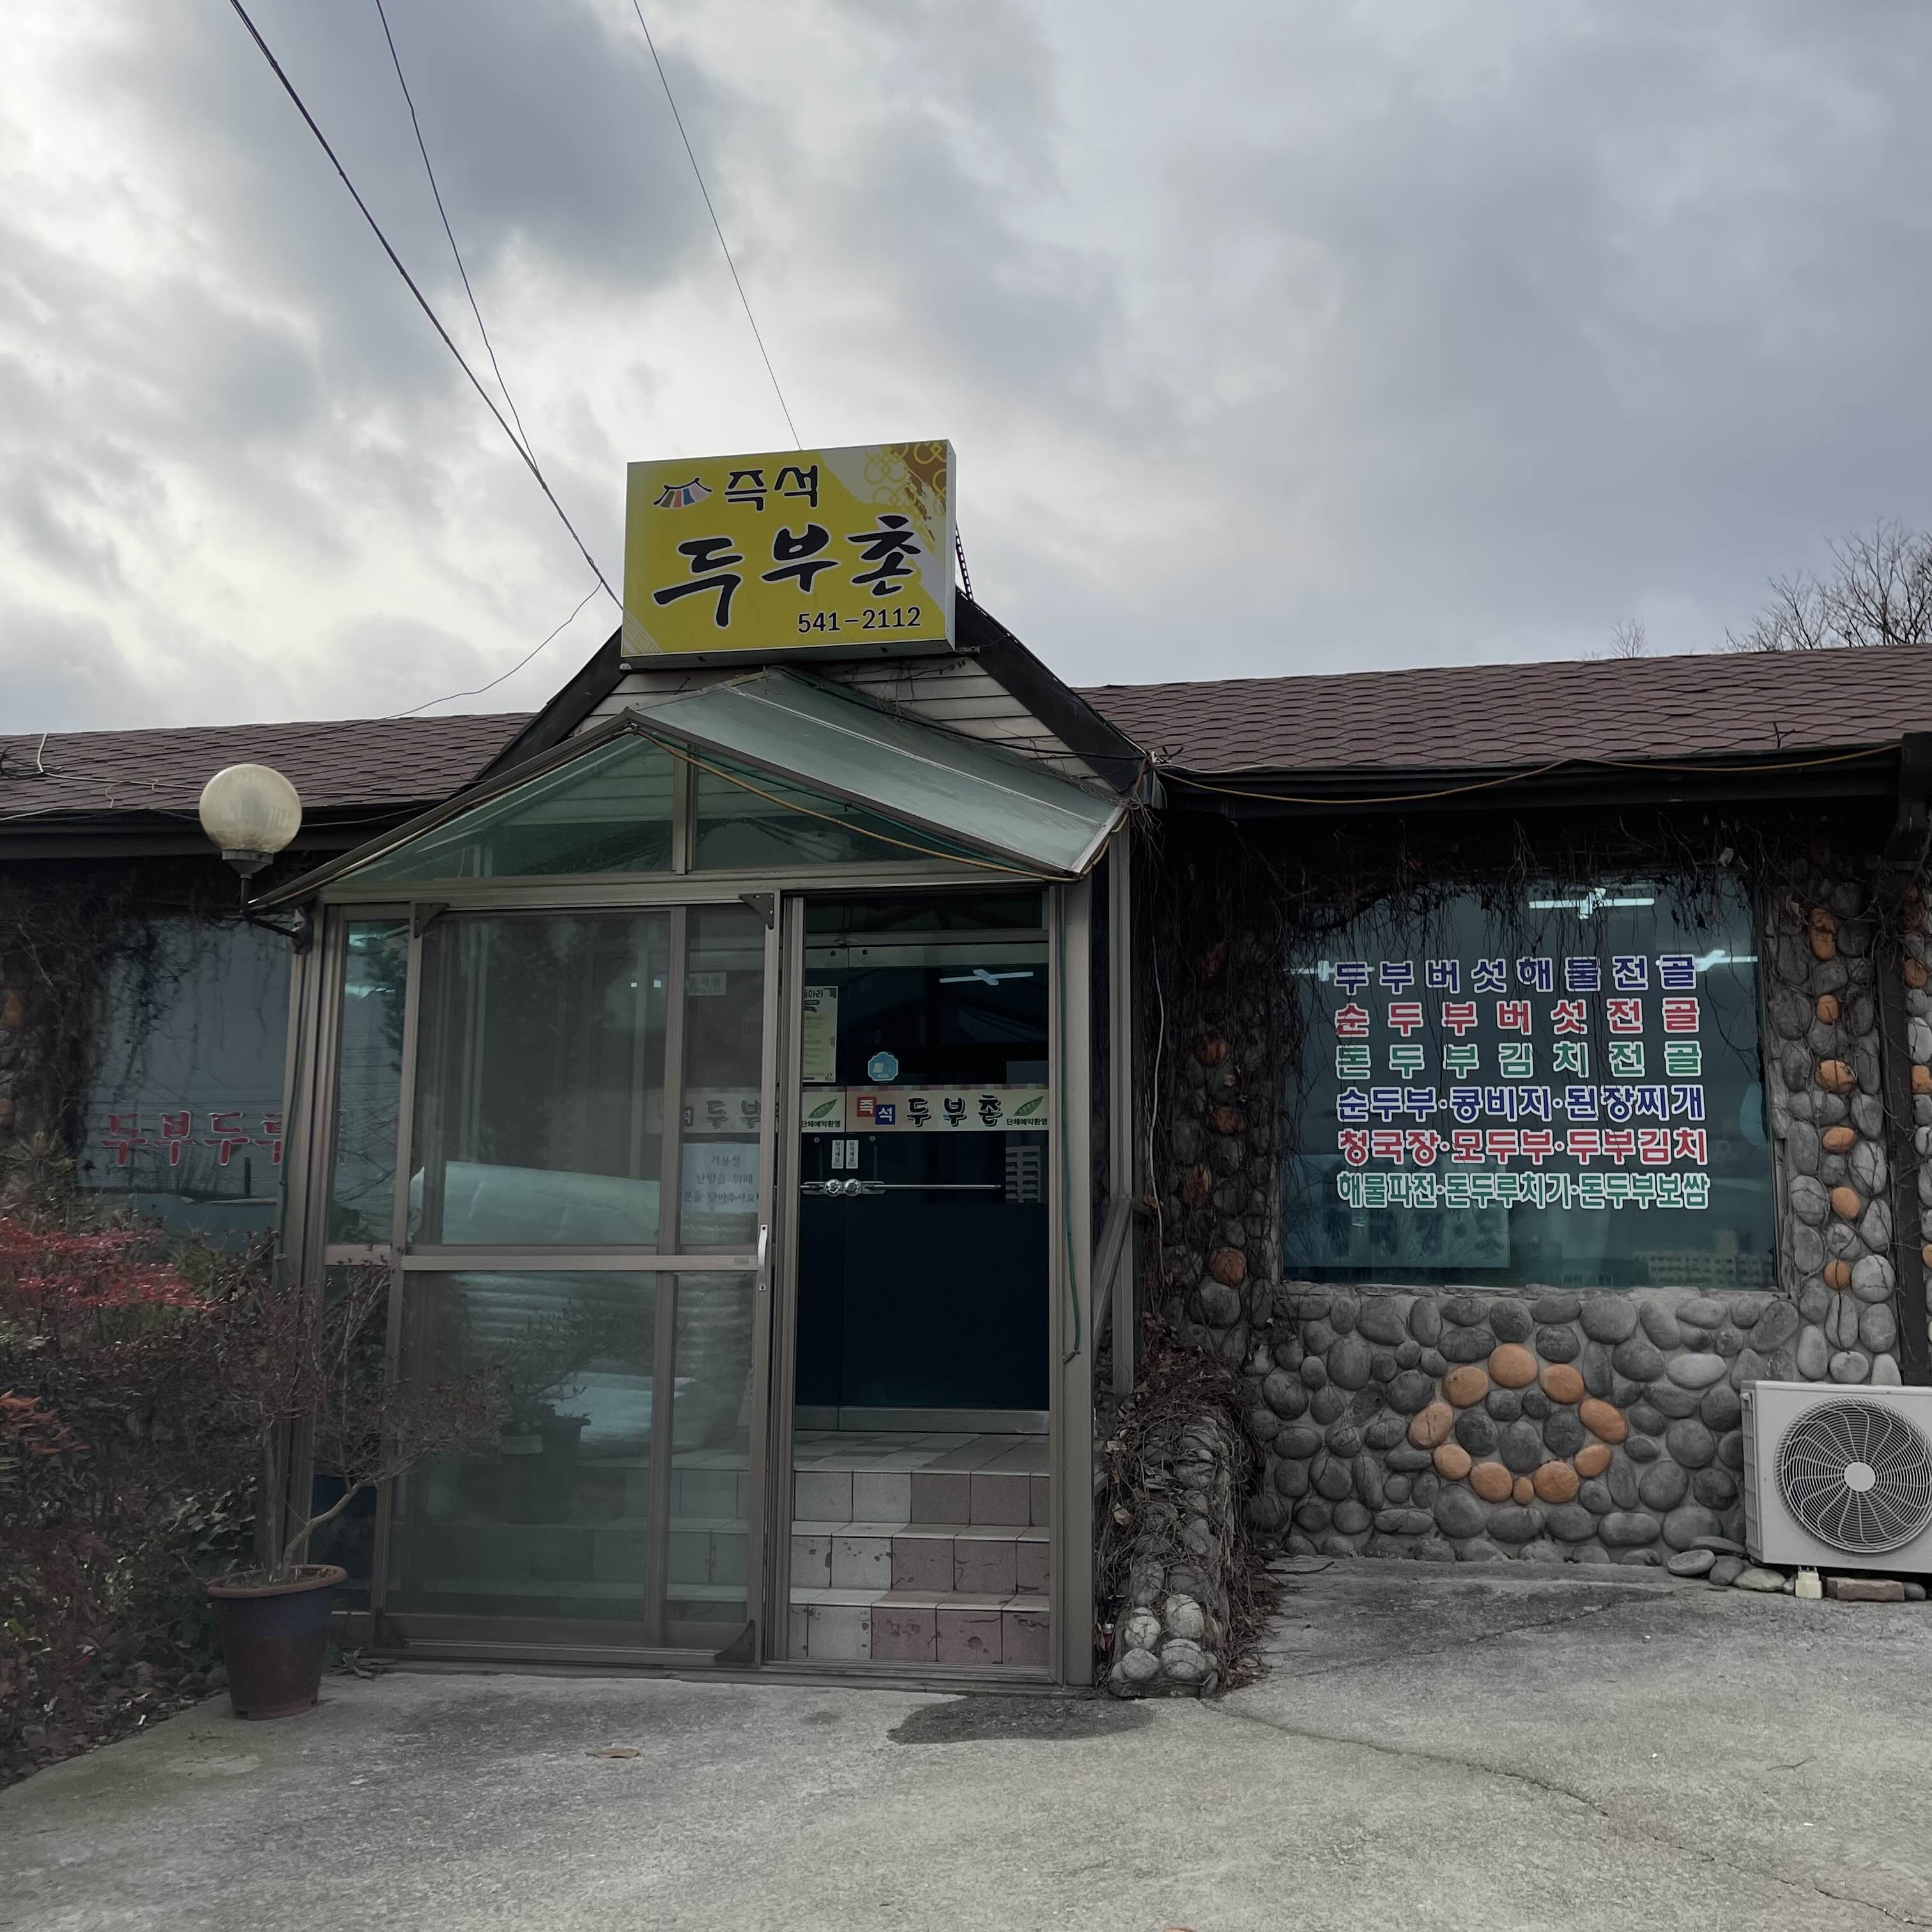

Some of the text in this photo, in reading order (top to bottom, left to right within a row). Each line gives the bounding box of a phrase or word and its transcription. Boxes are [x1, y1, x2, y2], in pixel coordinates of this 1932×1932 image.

[724, 465, 818, 511] 즉석
[654, 515, 921, 627] 두부촌
[797, 606, 921, 633] 541-2112
[1334, 954, 1696, 995] 두부버섯해물전골
[1335, 997, 1699, 1038] 순두부버섯전골
[859, 1094, 1003, 1128] 즉석 두부촌
